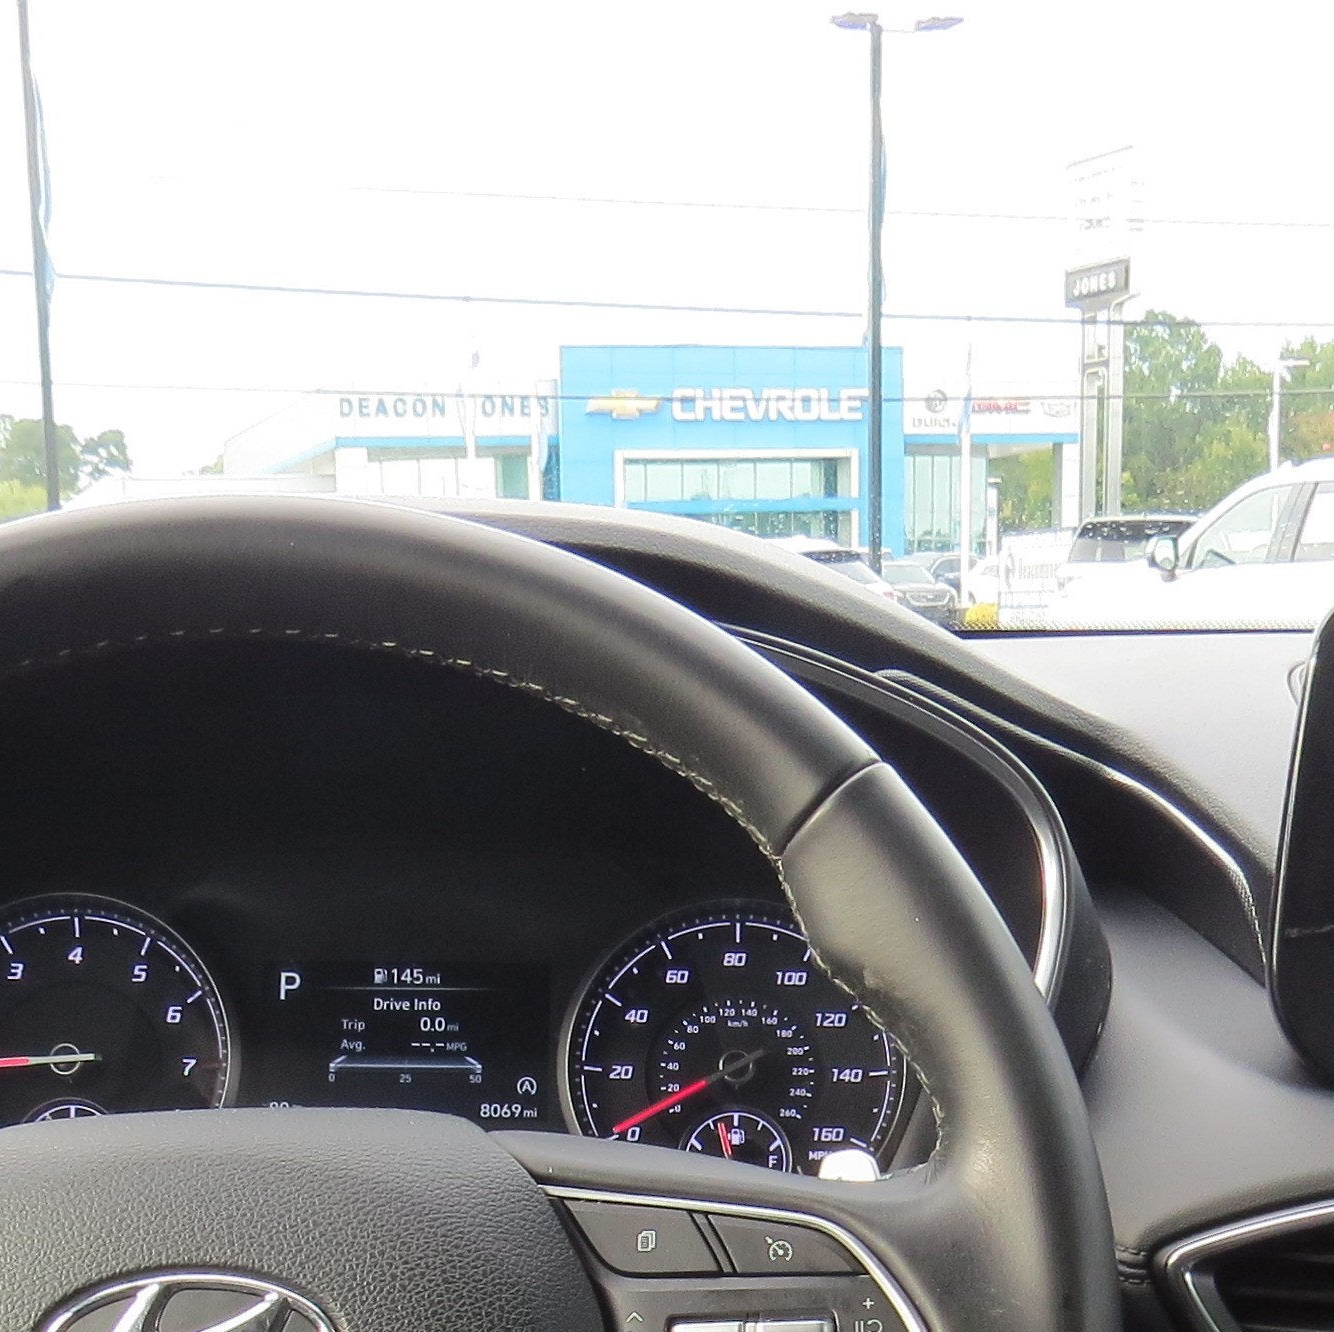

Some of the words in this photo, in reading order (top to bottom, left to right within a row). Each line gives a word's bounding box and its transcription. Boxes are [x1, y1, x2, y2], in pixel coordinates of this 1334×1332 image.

[1073, 270, 1116, 297] JONES
[339, 397, 446, 418] DEACON
[477, 394, 549, 417] ONES
[671, 387, 871, 421] CHEVROLE
[68, 947, 83, 963] 4
[723, 952, 747, 968] 80
[8, 964, 24, 980] 3
[131, 966, 148, 982] 5
[391, 968, 423, 984] 145
[426, 974, 440, 984] mi
[666, 969, 689, 985] 60
[776, 970, 808, 986] 100
[279, 972, 301, 1000] P
[374, 998, 409, 1010] Drive
[414, 998, 441, 1010] Info
[167, 1007, 183, 1023] 6
[625, 1008, 649, 1025] 40
[741, 1009, 758, 1017] 140
[761, 1017, 778, 1025] 160
[815, 1012, 847, 1028] 120
[341, 1019, 365, 1032] Trip
[420, 1017, 445, 1032] 0.0
[447, 1023, 459, 1031] mi
[341, 1039, 366, 1051] Avg.
[446, 1042, 467, 1051] MPG
[673, 1042, 685, 1050] 60
[787, 1047, 804, 1055] 200
[183, 1059, 196, 1076] 7
[609, 1064, 633, 1080] 20
[831, 1067, 863, 1083] 140
[328, 1074, 335, 1082] 0
[400, 1074, 411, 1082] 25
[469, 1075, 482, 1083] 50
[480, 1104, 521, 1117] 8069
[523, 1108, 537, 1117] mi
[626, 1126, 640, 1142] 0
[812, 1126, 844, 1142] 160
[768, 1156, 777, 1167] F
